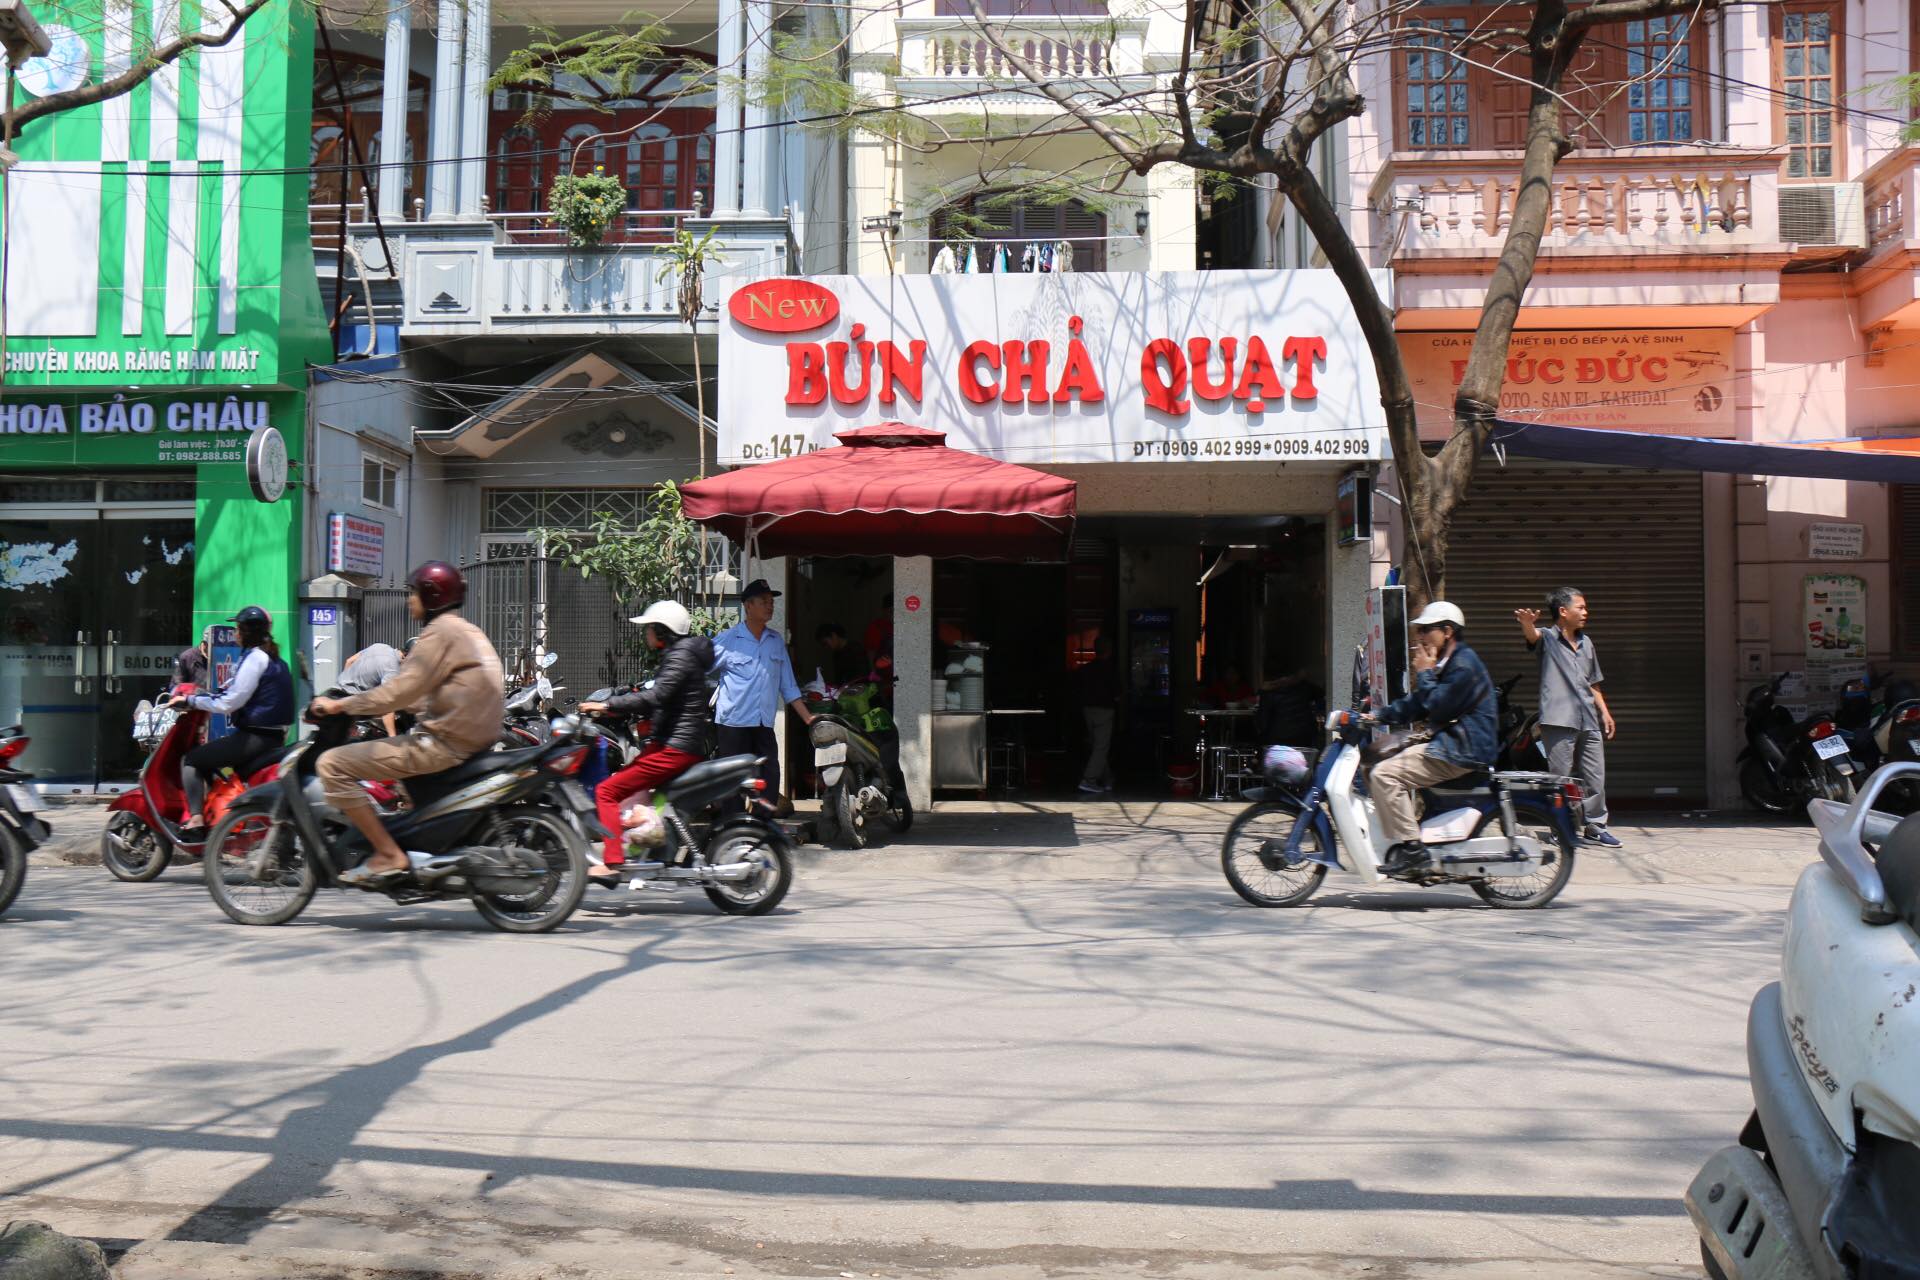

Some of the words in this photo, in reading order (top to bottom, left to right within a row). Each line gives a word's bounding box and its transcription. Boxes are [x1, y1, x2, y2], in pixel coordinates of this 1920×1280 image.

[745, 292, 827, 320] New
[1511, 336, 1539, 346] HIẾT
[1654, 335, 1684, 344] SINH
[74, 351, 120, 371] KHOA
[125, 346, 171, 371] RĂNG
[177, 346, 215, 371] HÀM
[221, 346, 259, 374] MẶT
[785, 323, 927, 404] BÚN
[958, 316, 1105, 403] CHẢ
[1141, 335, 1328, 414] QUẠT
[1575, 349, 1668, 384] ĐỨC
[81, 393, 154, 433] BẢO
[167, 395, 271, 432] CHÂU
[1501, 392, 1531, 409] OTO
[1542, 391, 1570, 408] SAN
[1600, 390, 1667, 407] KAKUDAI
[1343, 439, 1369, 455] 909
[312, 609, 332, 622] 145
[1788, 1015, 1829, 1080] Spacy
[1823, 1075, 1840, 1094] 125
